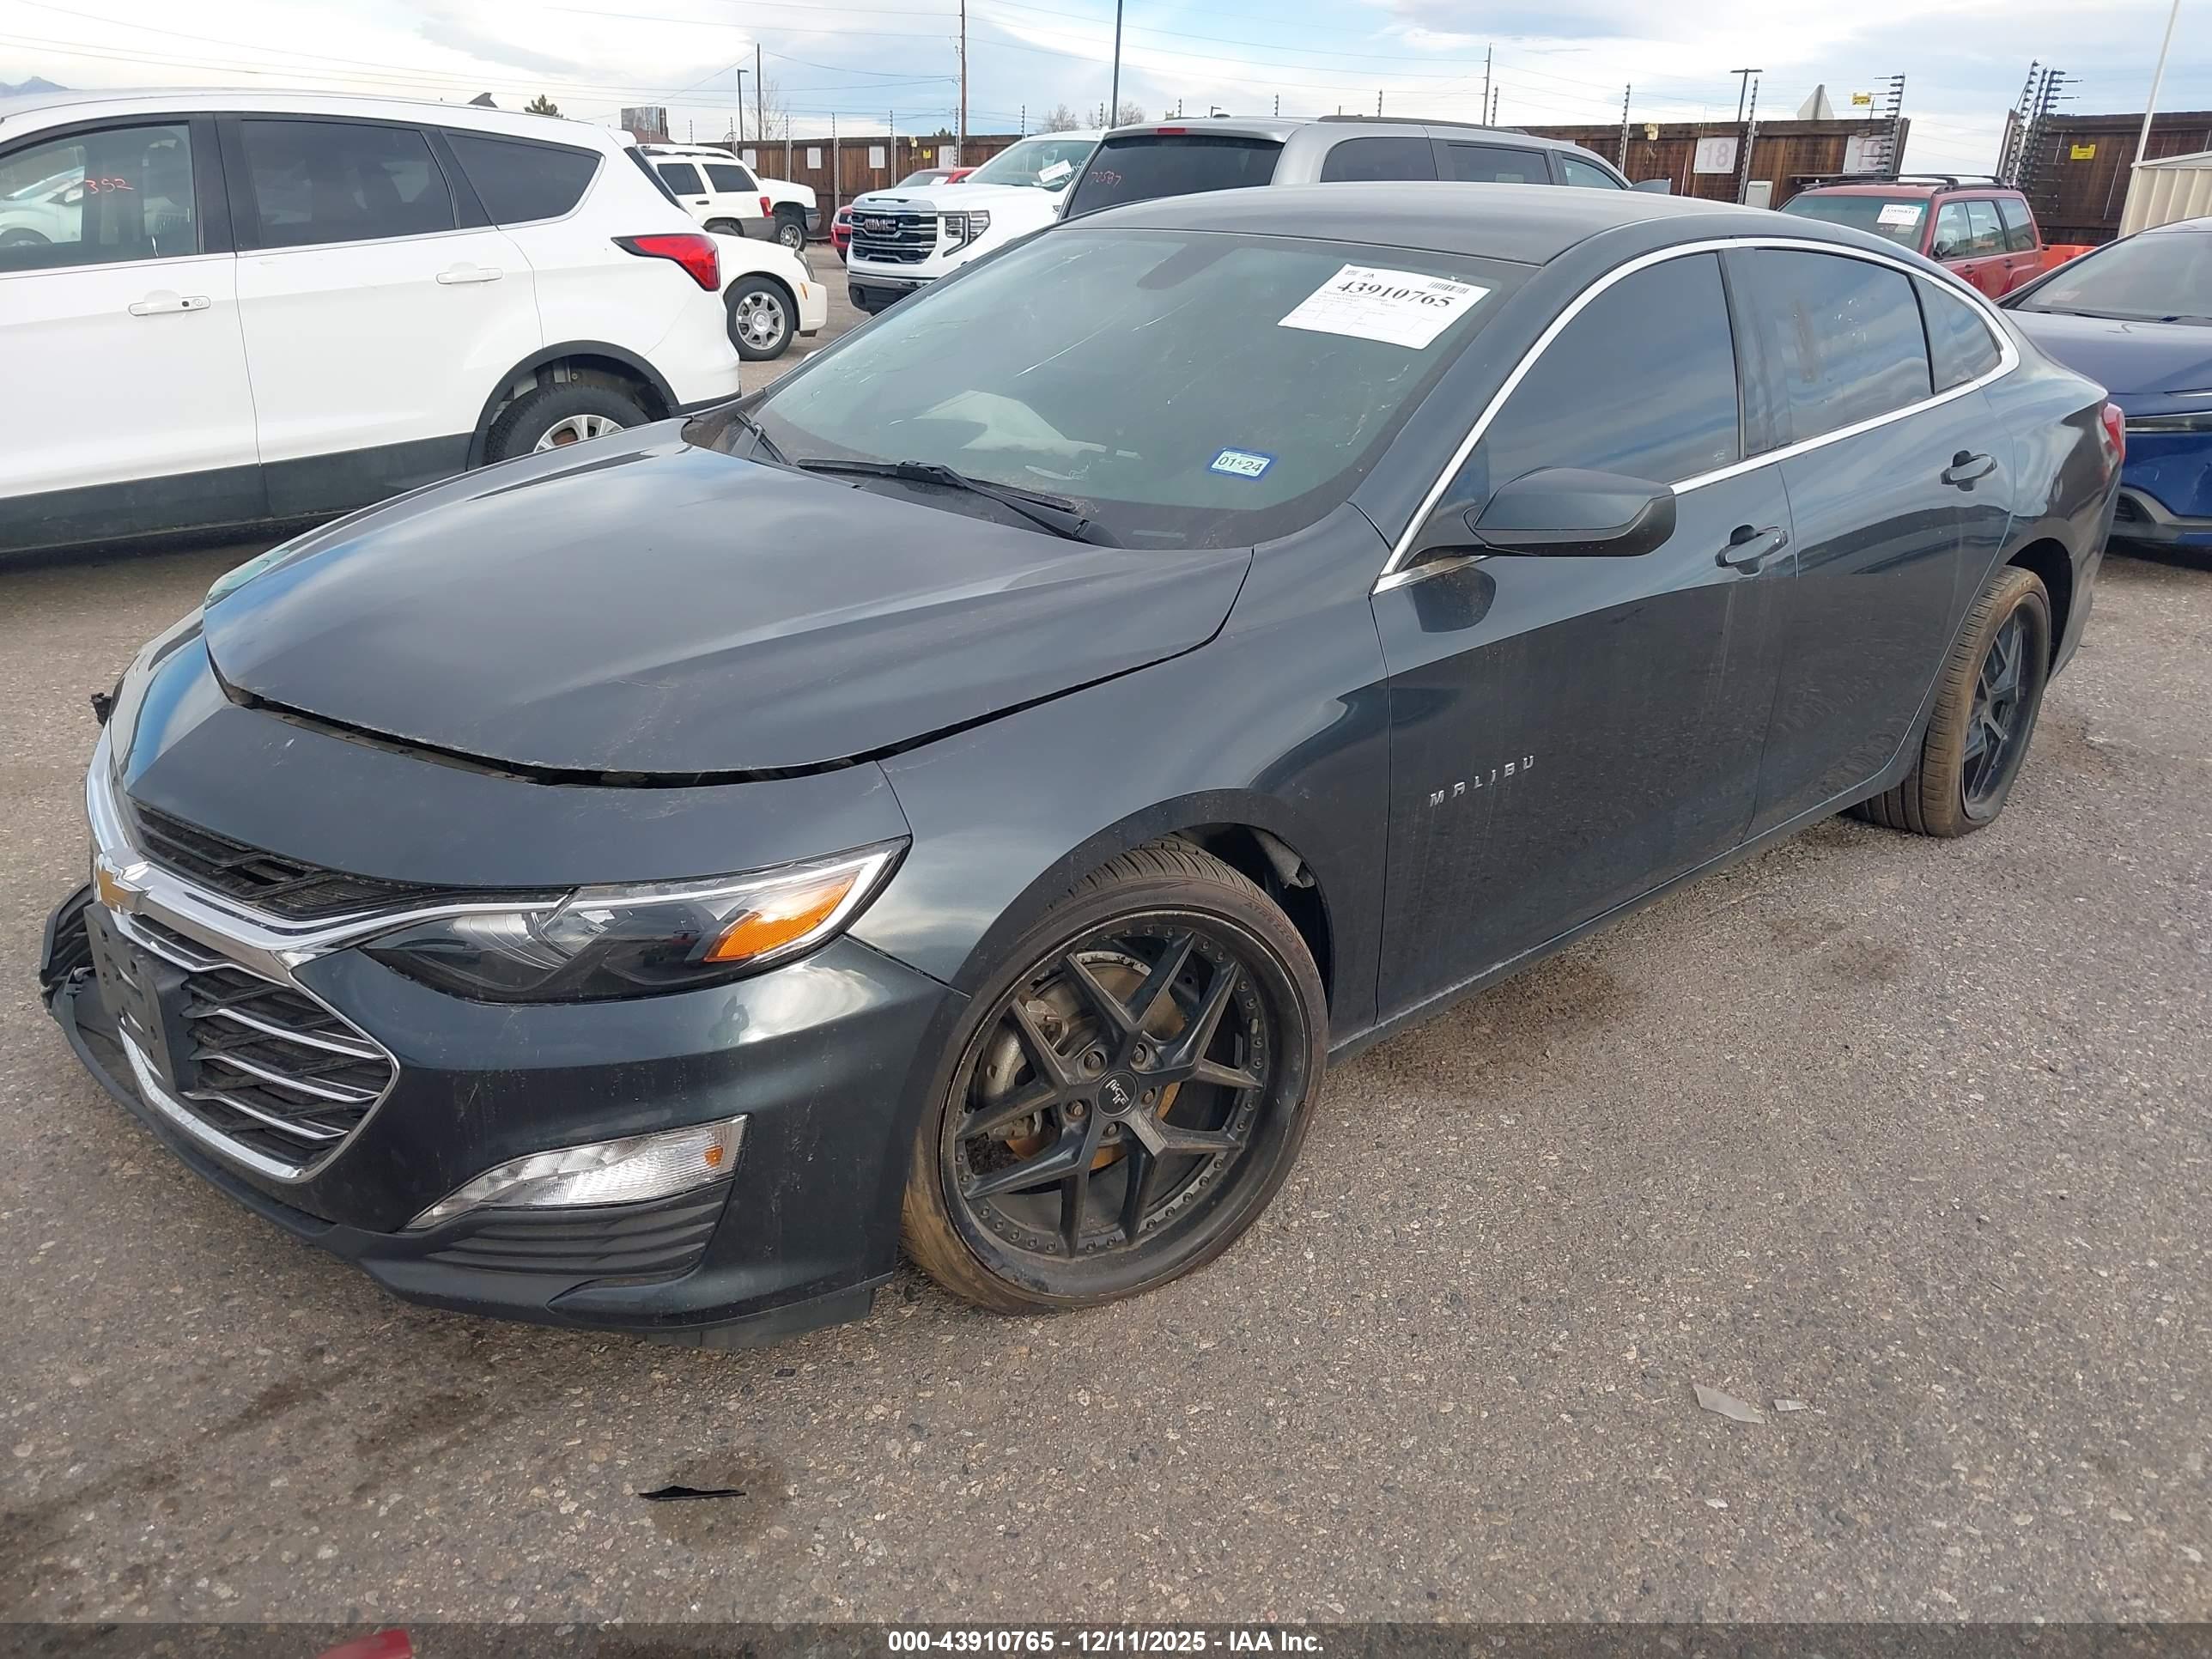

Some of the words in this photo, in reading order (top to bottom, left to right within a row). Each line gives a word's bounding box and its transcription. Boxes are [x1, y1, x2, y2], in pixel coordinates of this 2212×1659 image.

[1704, 142, 1729, 167] 18
[84, 178, 136, 194] 352
[864, 217, 896, 231] GMC
[1336, 279, 1456, 308] 43910765
[1428, 755, 1535, 808] MALIBU
